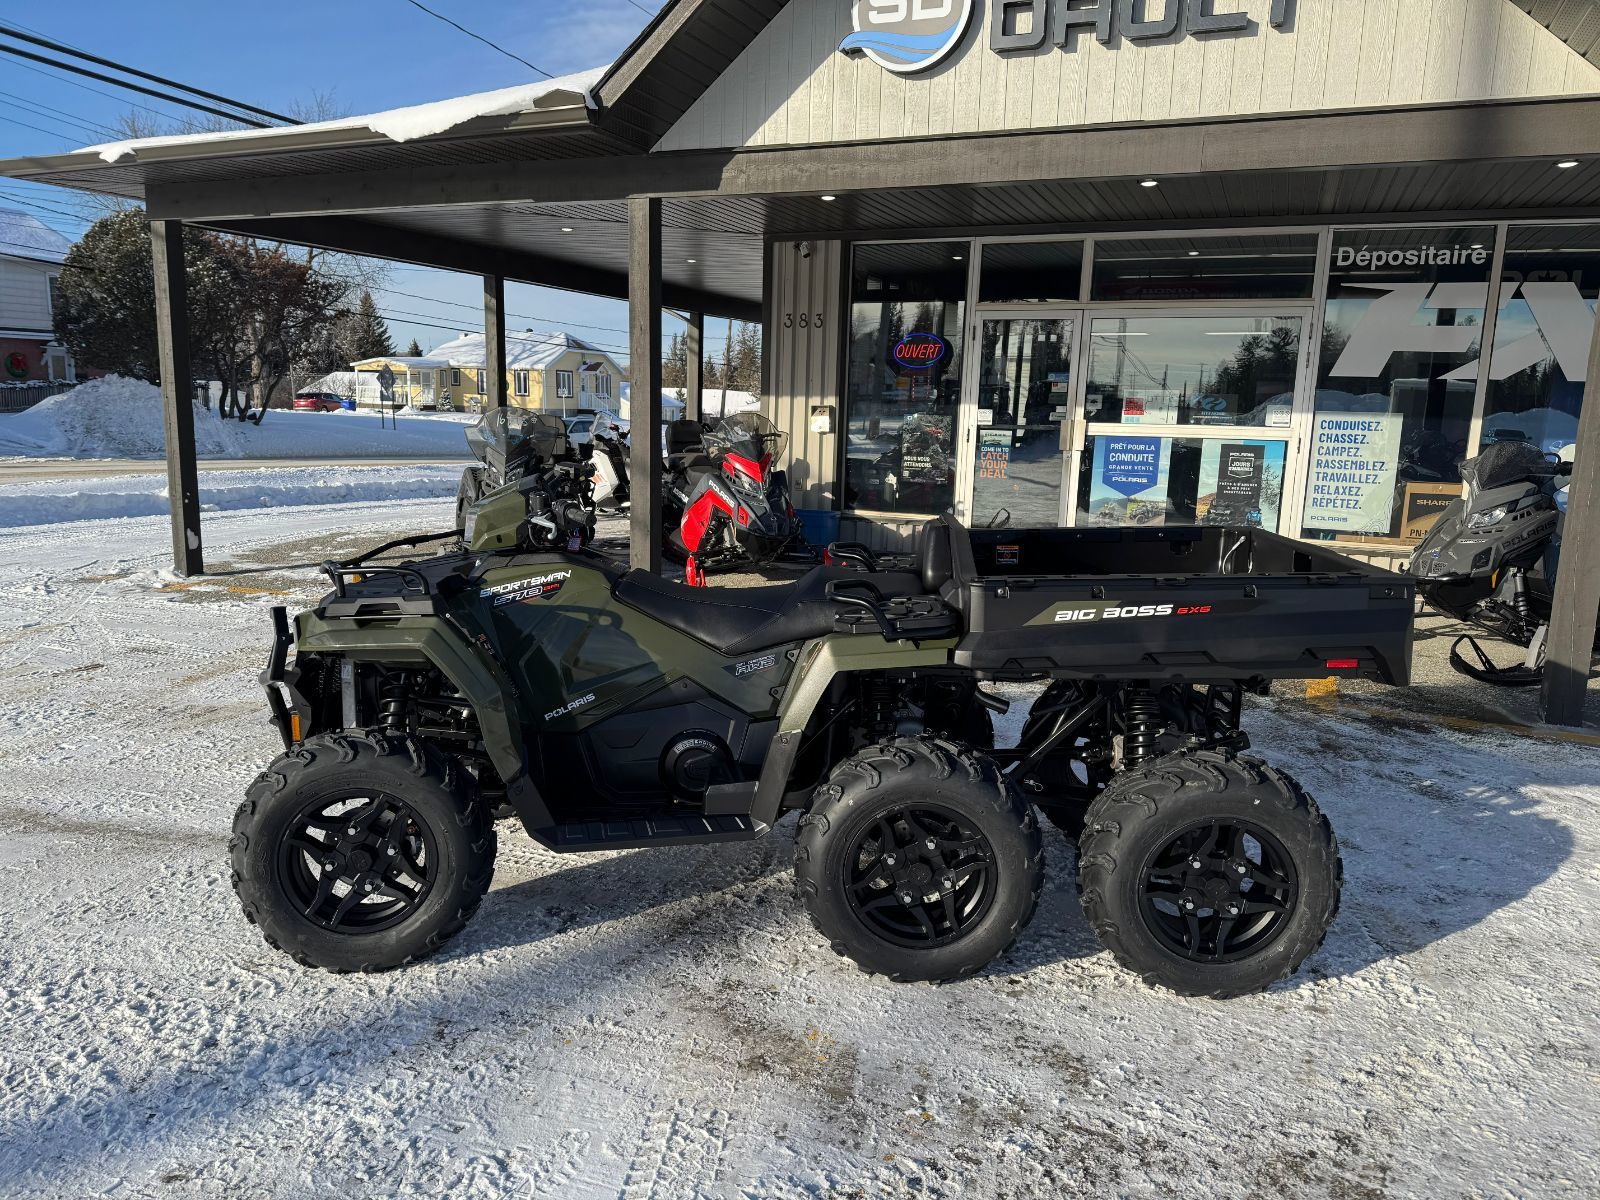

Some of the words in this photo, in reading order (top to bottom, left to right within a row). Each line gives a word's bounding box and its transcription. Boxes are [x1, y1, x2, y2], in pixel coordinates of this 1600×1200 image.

[1336, 245, 1488, 270] Dépositaire
[784, 313, 824, 329] 383
[895, 344, 941, 358] OUVERT
[1320, 420, 1383, 432] CONDUISEZ.
[1318, 433, 1369, 444] CHASSEZ.
[980, 452, 1009, 460] CATCH
[1109, 452, 1155, 463] CONDUITE
[1317, 446, 1363, 457] CAMPEZ.
[981, 460, 1008, 469] YOUR
[1315, 459, 1388, 471] RASSEMBLEZ.
[980, 469, 1008, 479] DEAL
[1314, 472, 1381, 484] TRAVAILLEZ.
[708, 479, 736, 508] POLARIS
[1313, 485, 1363, 497] RELAXEZ.
[1312, 495, 1362, 510] RÉPÉTEZ.
[1501, 519, 1557, 550] POLARIS
[480, 569, 572, 598] SPORTSMAN
[1054, 608, 1097, 622] BIG
[1102, 604, 1174, 619] BOSS
[543, 692, 596, 721] POLARIS
